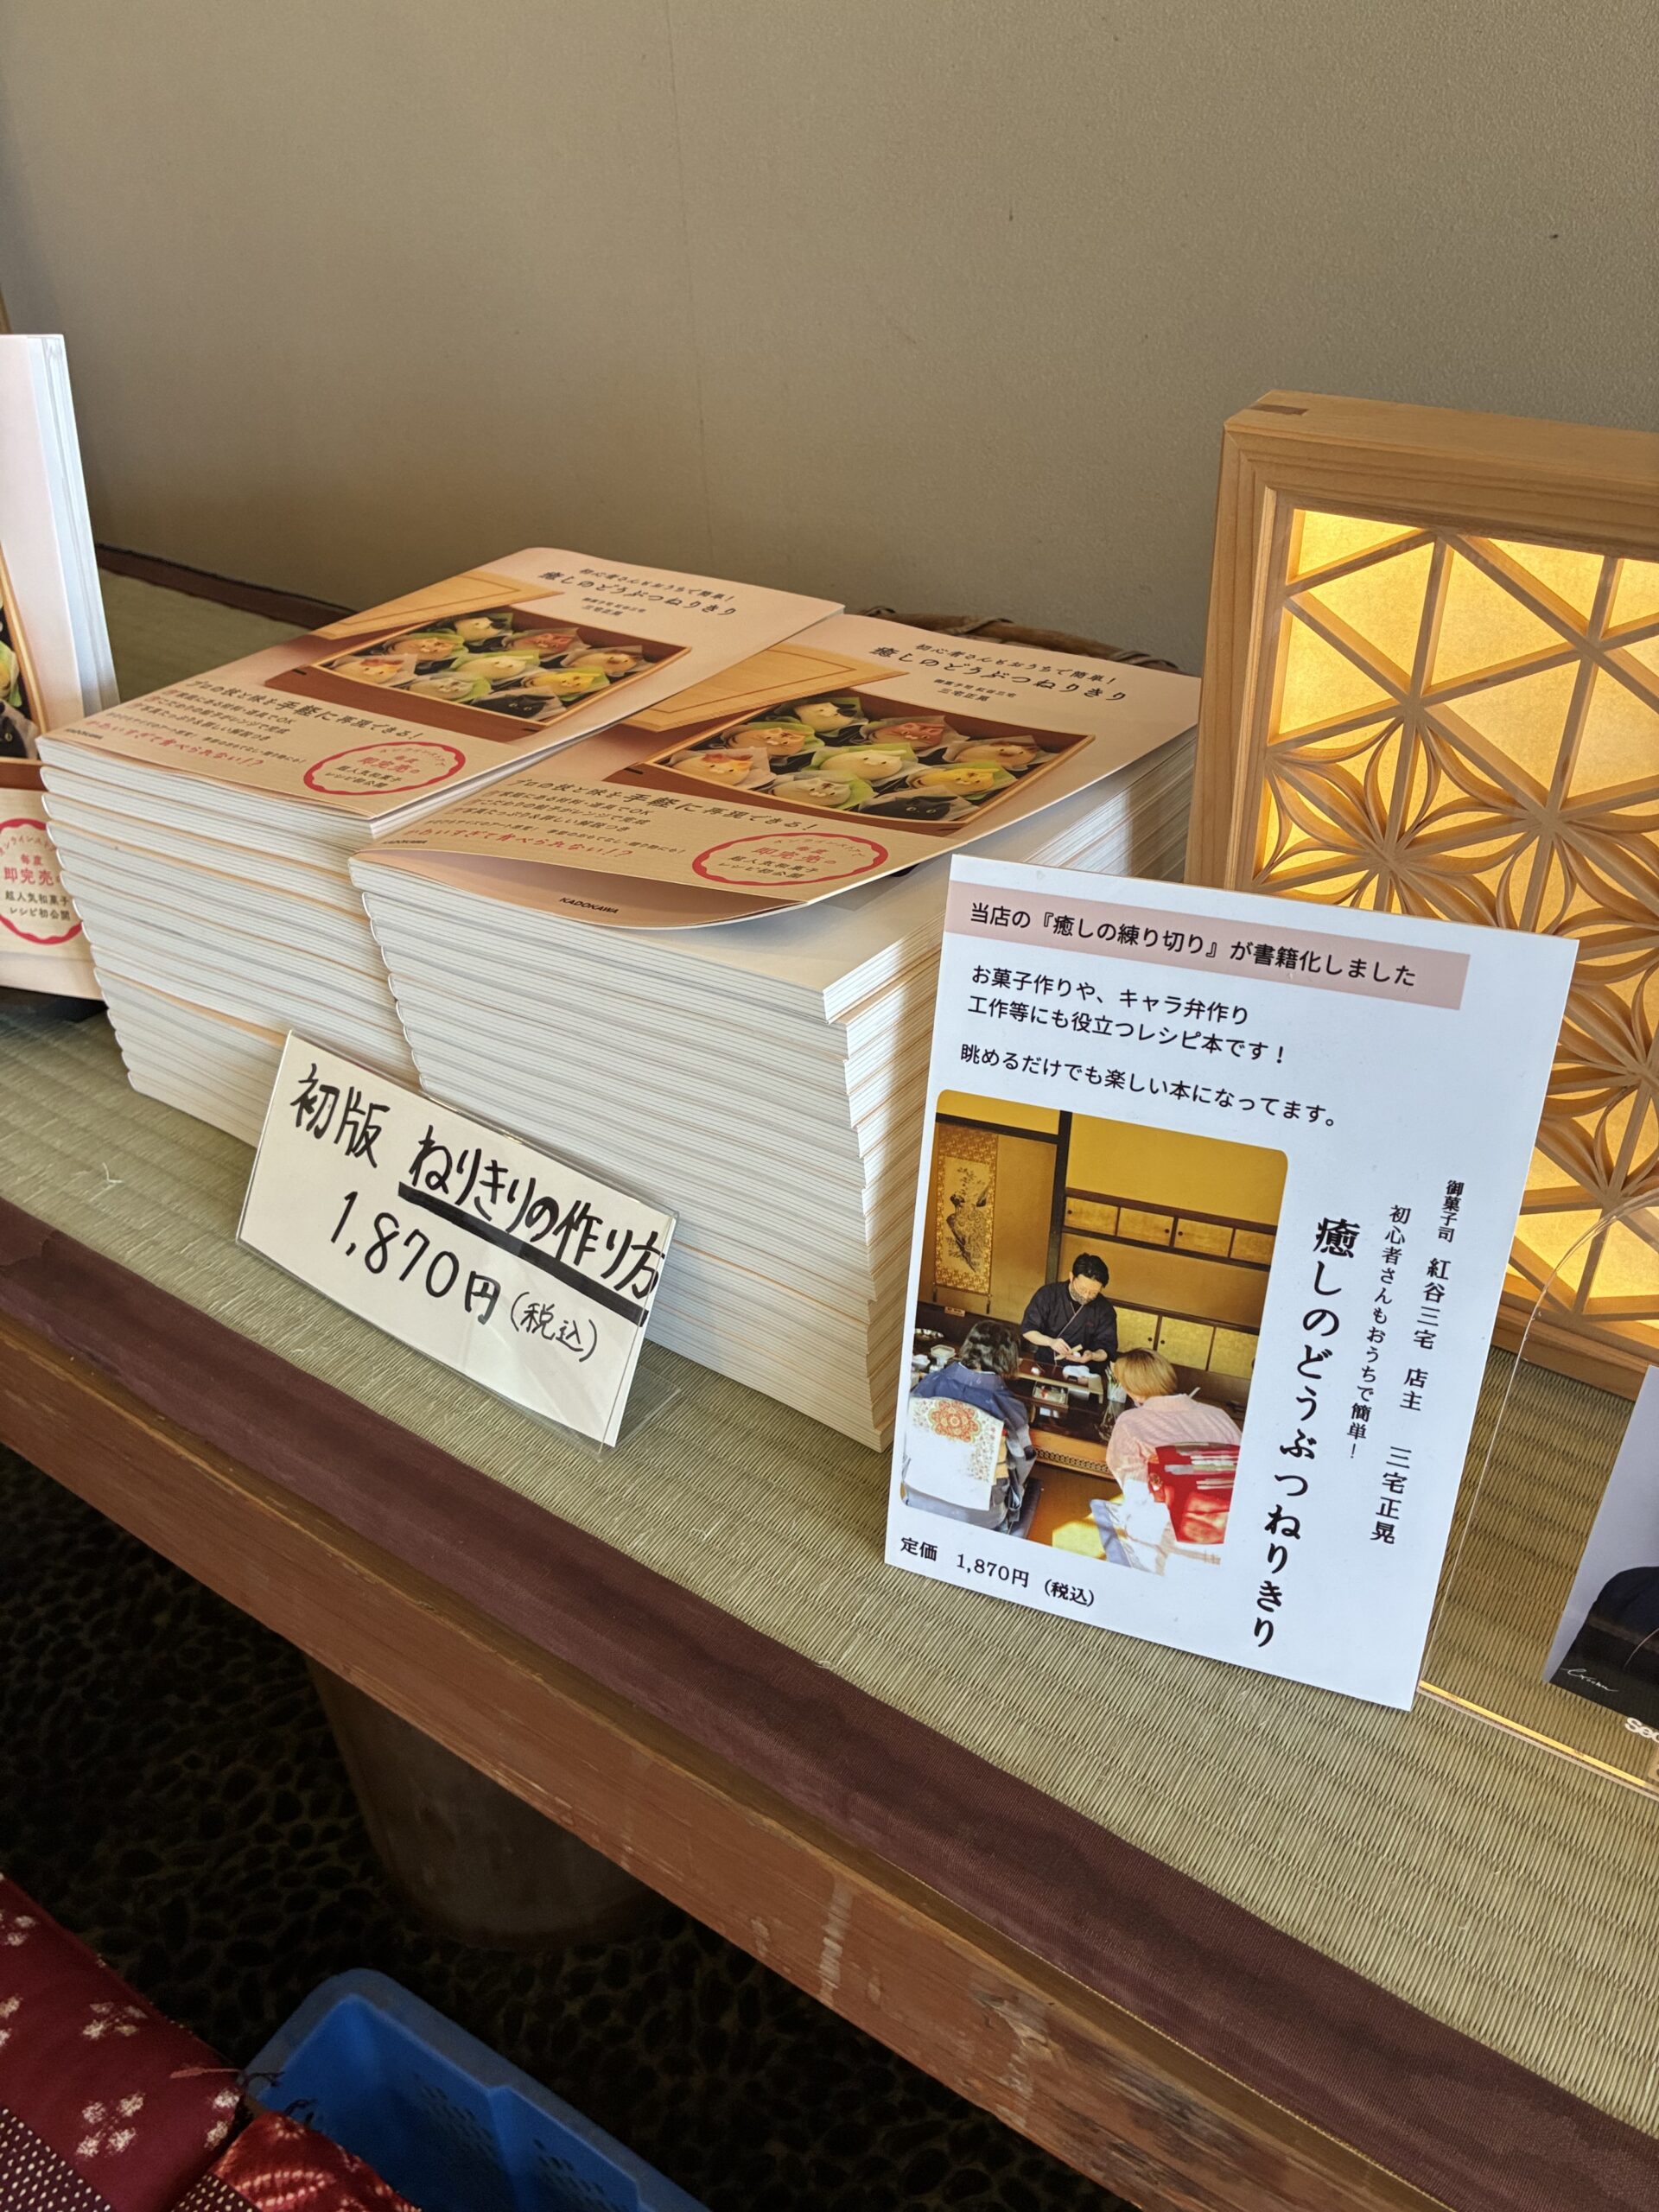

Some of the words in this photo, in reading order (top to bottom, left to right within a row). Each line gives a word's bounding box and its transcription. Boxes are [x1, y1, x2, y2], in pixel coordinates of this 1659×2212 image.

[869, 646, 1127, 702] 癒しのどうぶつねりきり
[559, 897, 620, 914] KADOKAWA
[970, 902, 1416, 987] 当店の『癒しの練り切り』が書籍化しました
[971, 964, 1249, 1026] お菓子作りや、キャラ弁作り
[961, 1044, 1335, 1128] 眺めるだけでも楽しい本になってます。
[289, 1063, 391, 1168] 初版
[408, 1125, 666, 1300] ねりきりの作り方
[1437, 1179, 1465, 1243] 御菓子司
[1413, 1257, 1452, 1351] 紅谷三宅
[1400, 1368, 1429, 1412] 店主
[1254, 1217, 1361, 1648] 癒しのどうぶつねりきり
[1370, 1446, 1412, 1545] 三宅正晃
[900, 1536, 938, 1562] 定価
